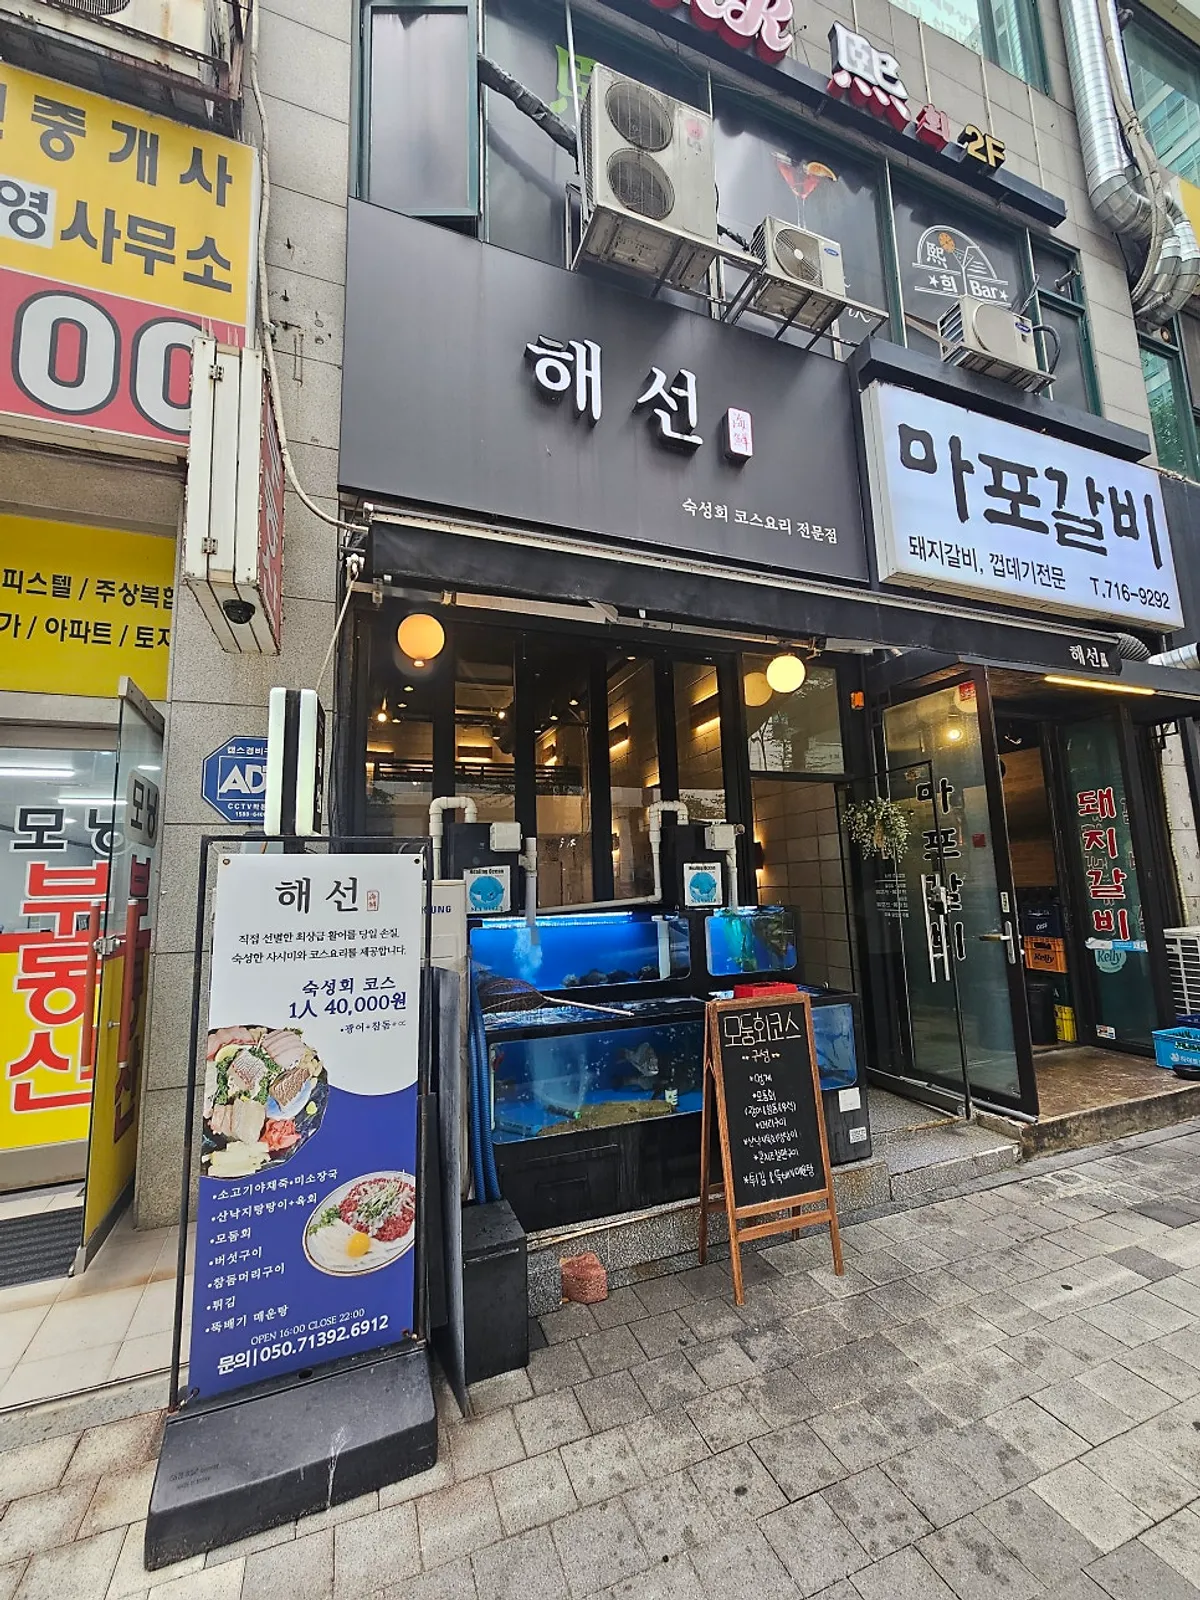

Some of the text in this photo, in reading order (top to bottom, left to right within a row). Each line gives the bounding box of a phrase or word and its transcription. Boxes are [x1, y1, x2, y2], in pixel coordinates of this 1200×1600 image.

[0, 84, 233, 207] 중개사
[964, 124, 1004, 167] 2F
[0, 180, 233, 293] 영사무소
[939, 275, 999, 300] 희 Bar
[525, 335, 703, 446] 해선
[898, 422, 1163, 571] 마포갈비
[682, 498, 838, 544] 숙성회 코스요리 전문점
[1, 568, 73, 600] 피스텔
[908, 534, 1171, 610] 돼지갈비, 껍데기전문 T.716-9292
[45, 617, 112, 647] 아파트
[1068, 644, 1101, 668] 해선
[219, 764, 268, 794] AD
[1076, 786, 1130, 941] 돼지갈비
[275, 876, 359, 915] 해선
[238, 933, 260, 945] 직접
[262, 932, 293, 944] 선별한
[295, 931, 326, 942] 최상급
[327, 929, 357, 941] 활어를
[358, 928, 377, 940] 당일
[231, 953, 264, 965] 숙성한
[266, 951, 308, 964] 사시미와
[309, 948, 357, 960] 코스요리를
[1033, 952, 1055, 963] Kelly
[1097, 946, 1123, 966] Kelly
[302, 976, 396, 998] 숙성회 코스
[288, 991, 407, 1020] 1人 40,000원
[214, 1246, 263, 1266] 버섯구이
[211, 1295, 236, 1312] 튀김
[210, 1304, 289, 1334] 뚝배기 매운탕
[250, 1307, 366, 1346] OPEN 16:00 CLOSE 22:00
